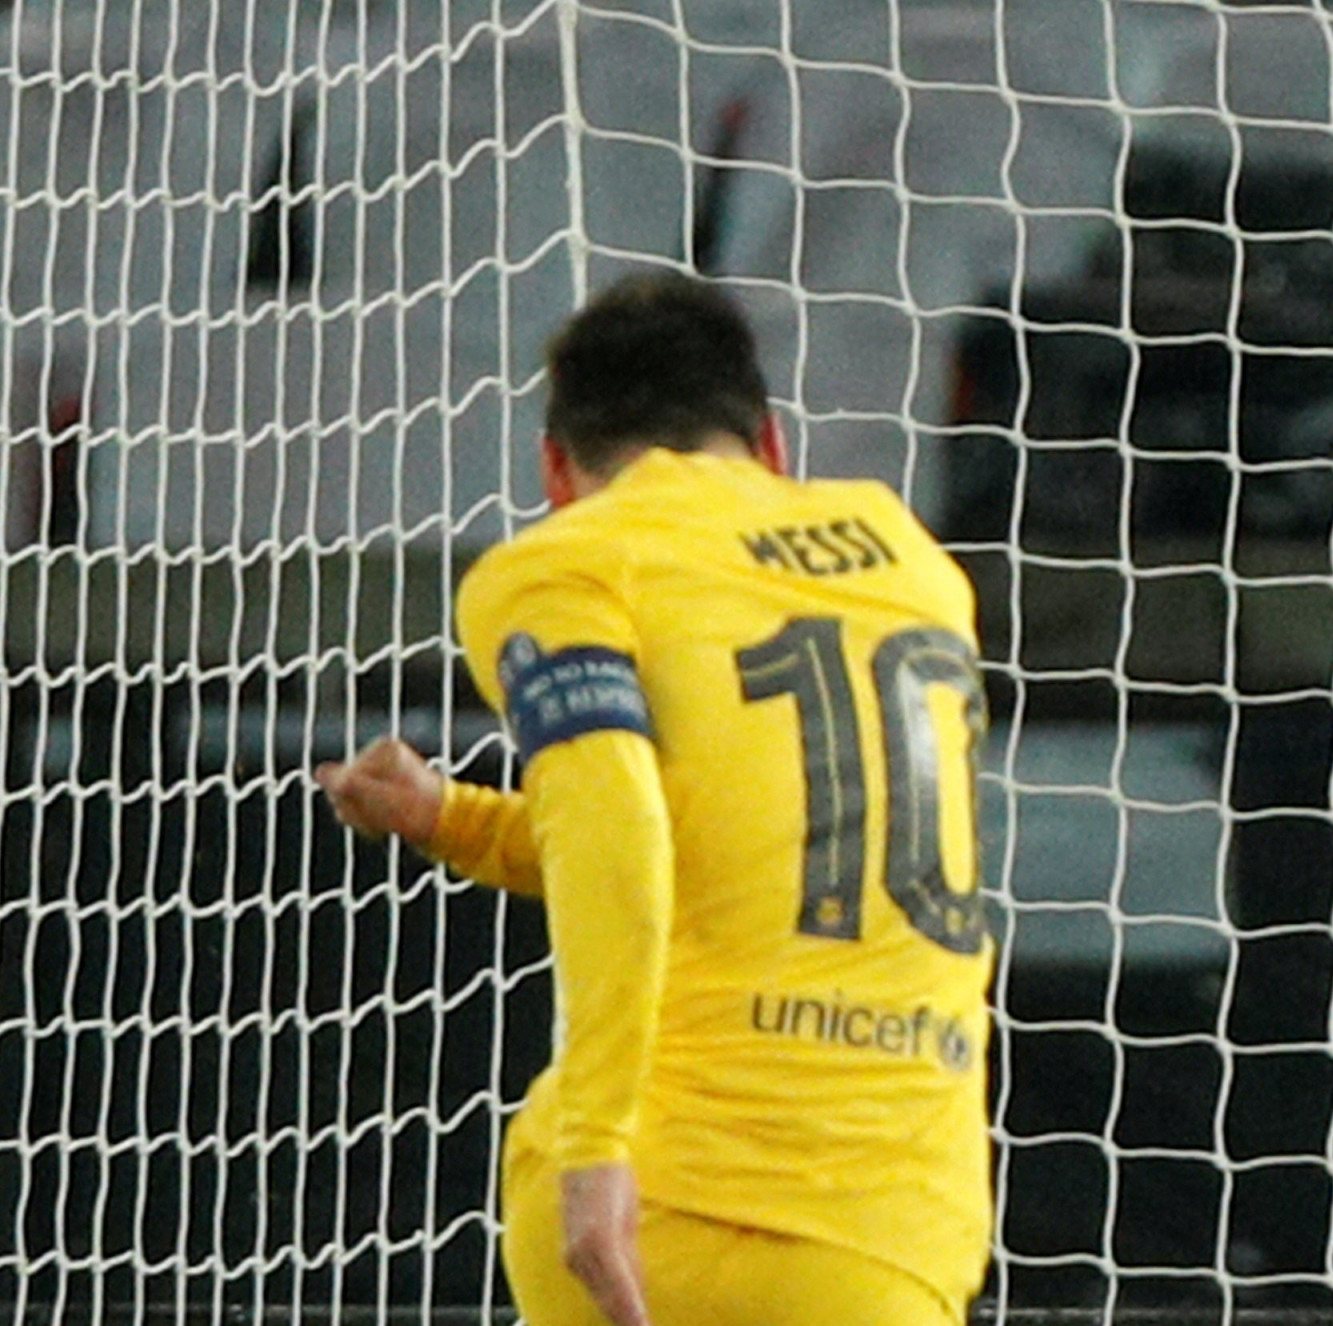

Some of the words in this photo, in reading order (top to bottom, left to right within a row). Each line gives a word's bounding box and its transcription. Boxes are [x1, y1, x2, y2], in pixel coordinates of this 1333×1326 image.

[738, 517, 898, 575] MESSI
[734, 614, 987, 954] 10
[752, 988, 931, 1056] unicef
